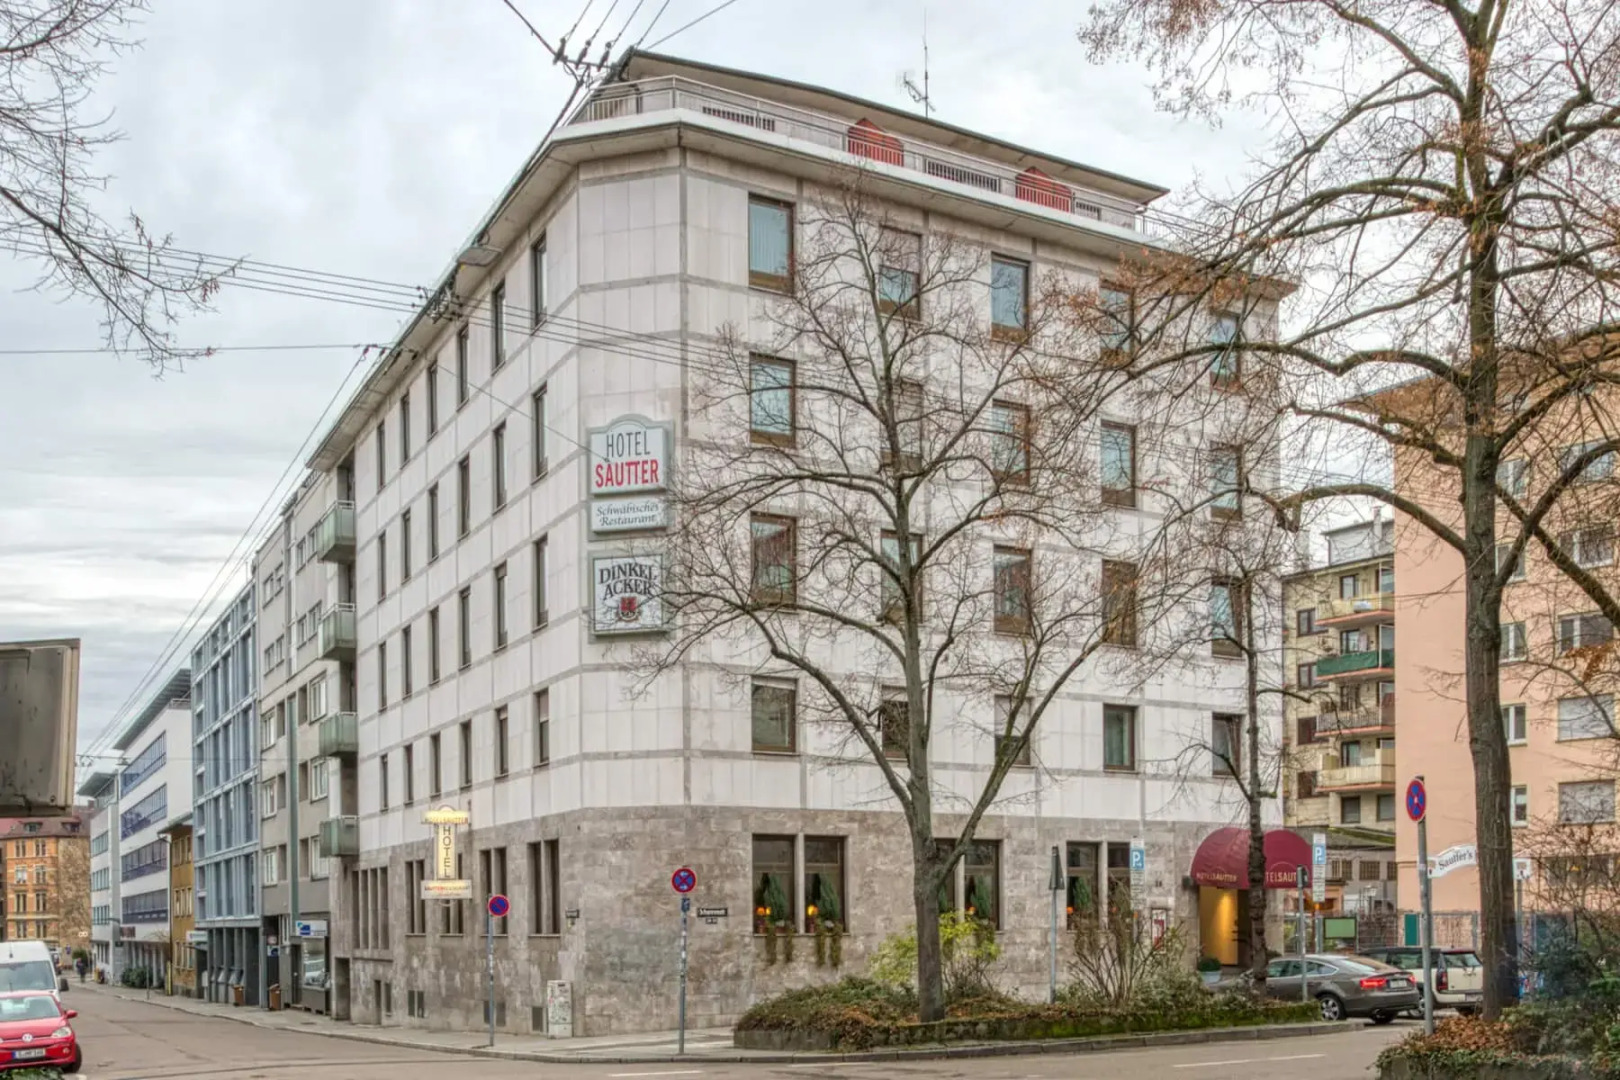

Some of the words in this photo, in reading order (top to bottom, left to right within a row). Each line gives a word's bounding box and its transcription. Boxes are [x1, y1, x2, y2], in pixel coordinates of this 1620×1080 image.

[606, 431, 650, 458] HOTEL
[595, 459, 659, 488] SAUTTER
[599, 514, 656, 527] Restaurant
[599, 563, 658, 584] DINKEL
[603, 579, 653, 600] ACKER
[443, 826, 451, 878] HOTEL
[1132, 851, 1140, 867] P
[1315, 846, 1322, 864] P
